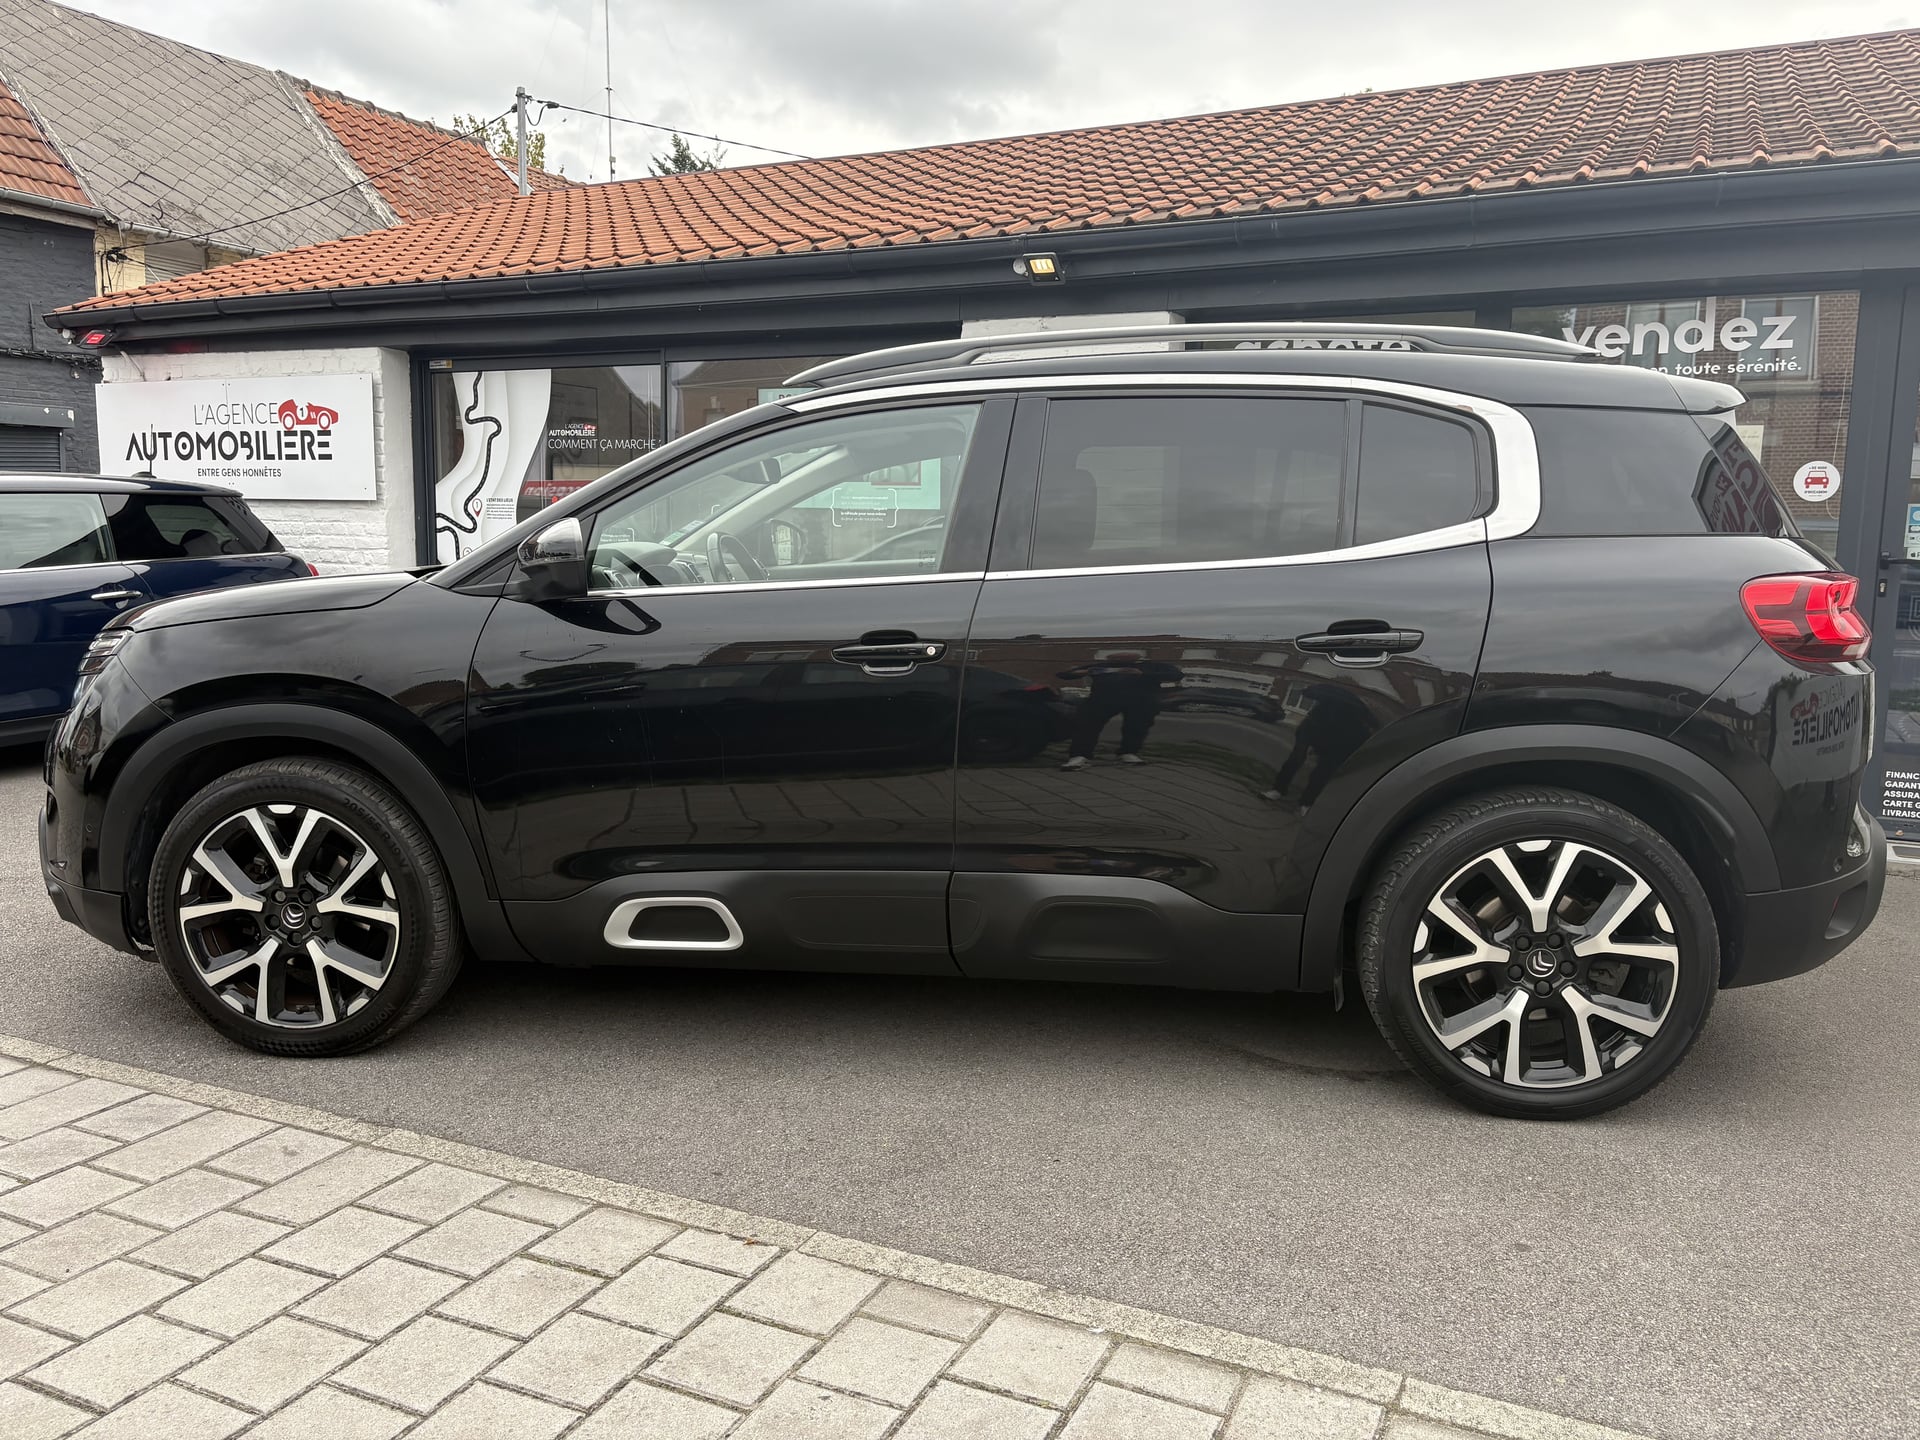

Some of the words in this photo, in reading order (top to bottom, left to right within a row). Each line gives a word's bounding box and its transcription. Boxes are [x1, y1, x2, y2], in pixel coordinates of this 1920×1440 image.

[1562, 296, 1797, 358] vendez
[1675, 363, 1721, 376] toute
[1727, 356, 1802, 373] sérénité.
[194, 402, 279, 425] L'AGENCE
[547, 438, 598, 449] COMMENT
[599, 438, 613, 452] ÇA
[615, 438, 656, 450] MARCHE
[198, 468, 220, 477] ENTRE
[221, 468, 241, 477] GENS
[242, 465, 282, 477] HONNÊTES
[1883, 790, 1920, 799] ASSURA
[1883, 799, 1913, 808] CARTE
